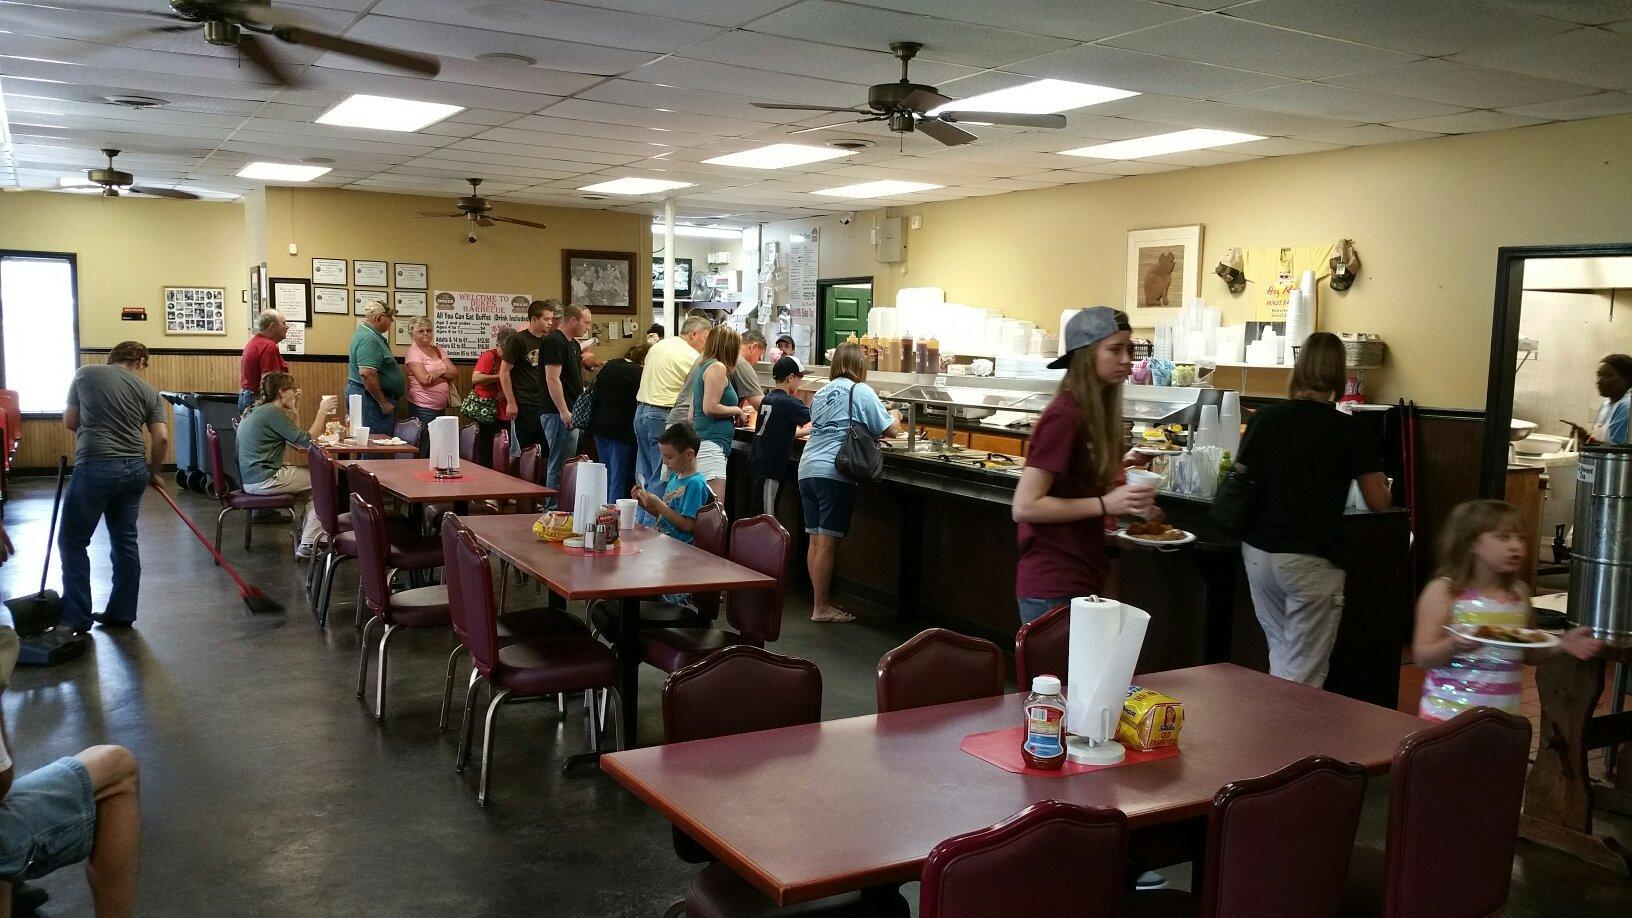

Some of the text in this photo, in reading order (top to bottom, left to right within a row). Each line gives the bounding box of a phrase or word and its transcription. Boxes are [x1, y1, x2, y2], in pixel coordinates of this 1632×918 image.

[459, 293, 497, 302] WELCOME
[470, 300, 497, 308] DUKES
[463, 305, 506, 314] BARBECUE
[436, 312, 444, 320] All
[444, 312, 455, 320] You
[455, 312, 465, 320] Can
[465, 313, 475, 321] Eat
[475, 313, 492, 321] Buffet
[756, 404, 773, 436] 7
